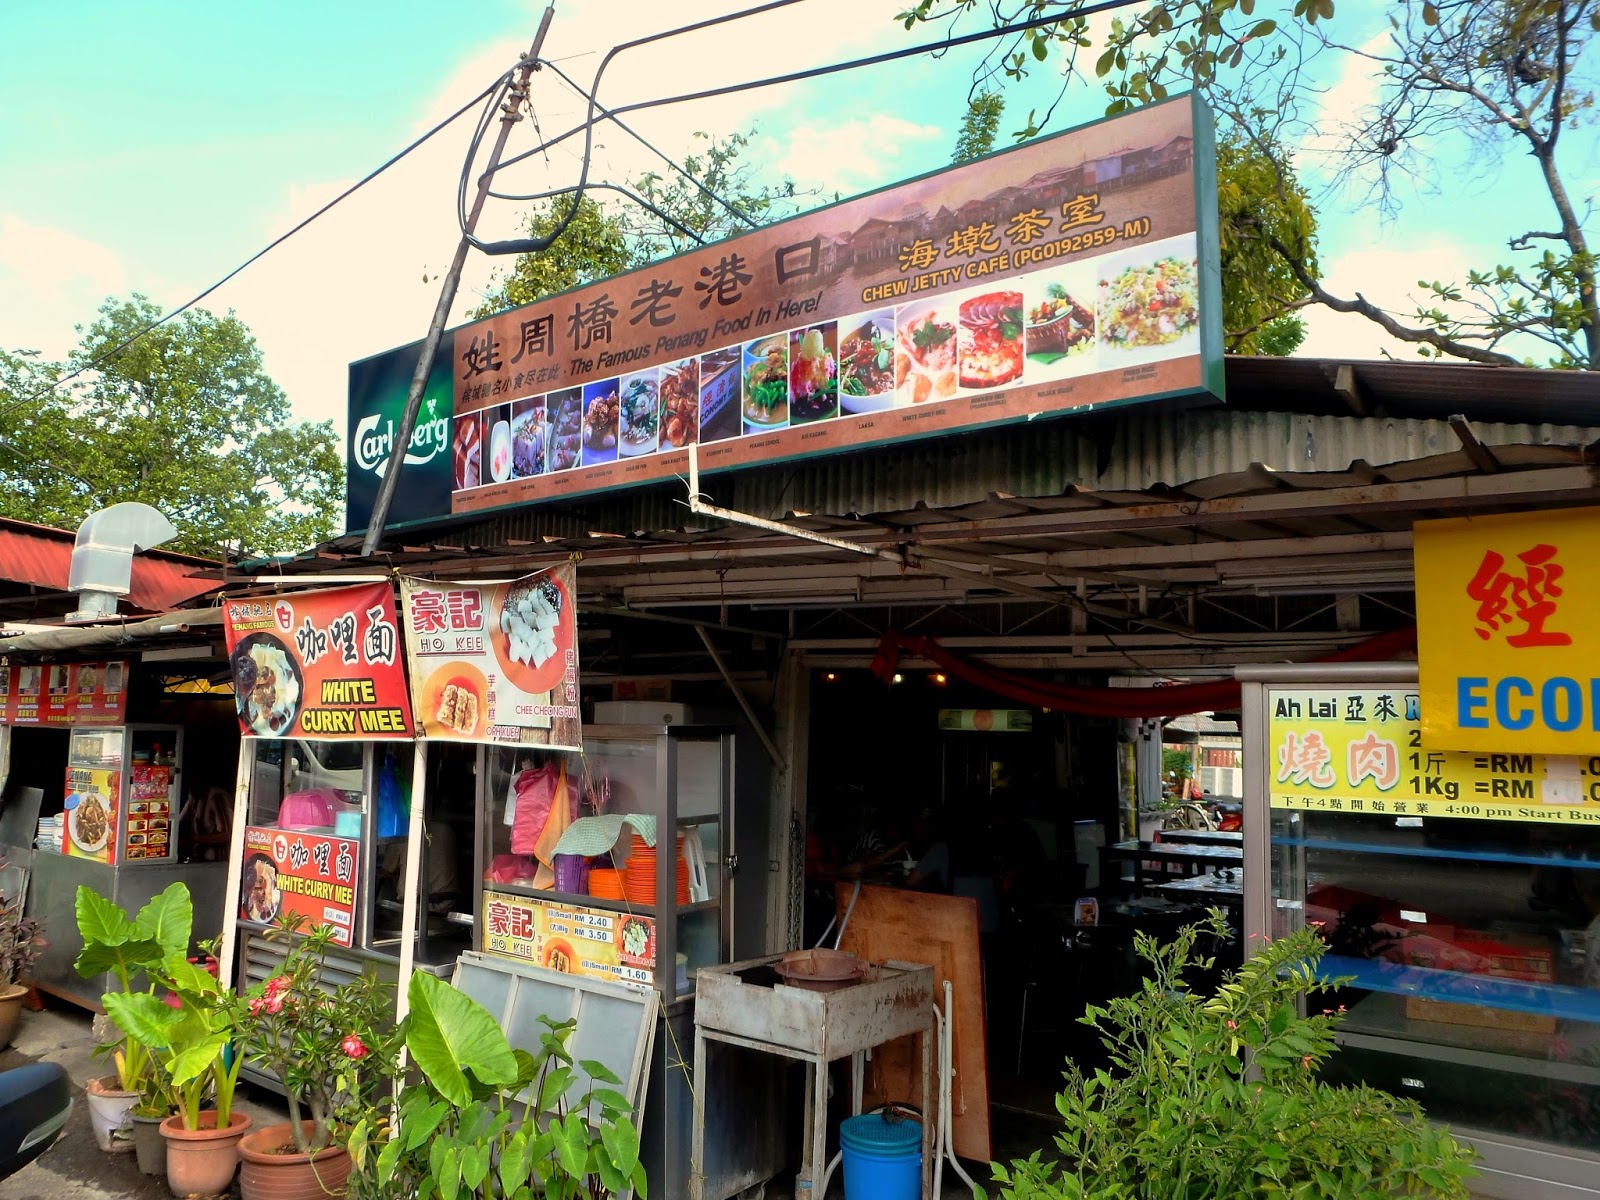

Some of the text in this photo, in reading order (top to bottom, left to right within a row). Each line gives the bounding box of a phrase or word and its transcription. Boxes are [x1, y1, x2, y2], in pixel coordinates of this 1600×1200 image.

[899, 193, 1104, 271] 海墘茶室
[862, 280, 908, 303] CHEW
[912, 266, 962, 296] JETTY
[966, 250, 1009, 279] CAFÉ
[462, 238, 821, 381] 姓周橋老港口
[570, 291, 823, 376] The Famous Penang Food In Here!
[858, 421, 874, 429] LAKSA
[354, 413, 449, 470] Carlerg
[1466, 543, 1573, 648] 經
[410, 589, 485, 633] 豪記
[420, 636, 484, 652] HO KEE
[321, 678, 376, 705] WHITE
[1457, 675, 1600, 733] ECO
[300, 708, 405, 733] CURRY MEE
[515, 705, 577, 718] CHEE CHEONG FUN
[1275, 698, 1337, 718] Ah Lai
[1344, 694, 1400, 723] 亞來
[486, 726, 520, 738] ORH KUEH
[1278, 731, 1399, 789] 燒肉
[1409, 776, 1460, 801] 1Kg
[1445, 804, 1481, 815] 4:00
[1486, 807, 1512, 818] pm
[1518, 807, 1563, 820] Start
[276, 873, 353, 905] WHITE CURRY MEE
[488, 901, 535, 941] 豪記
[574, 914, 585, 923] RM
[588, 916, 608, 928] 2.40
[574, 928, 585, 937] RM
[588, 930, 608, 941] 3.50
[491, 938, 533, 956] HO KEE
[611, 966, 622, 975] RM
[626, 968, 647, 981] 1.60
